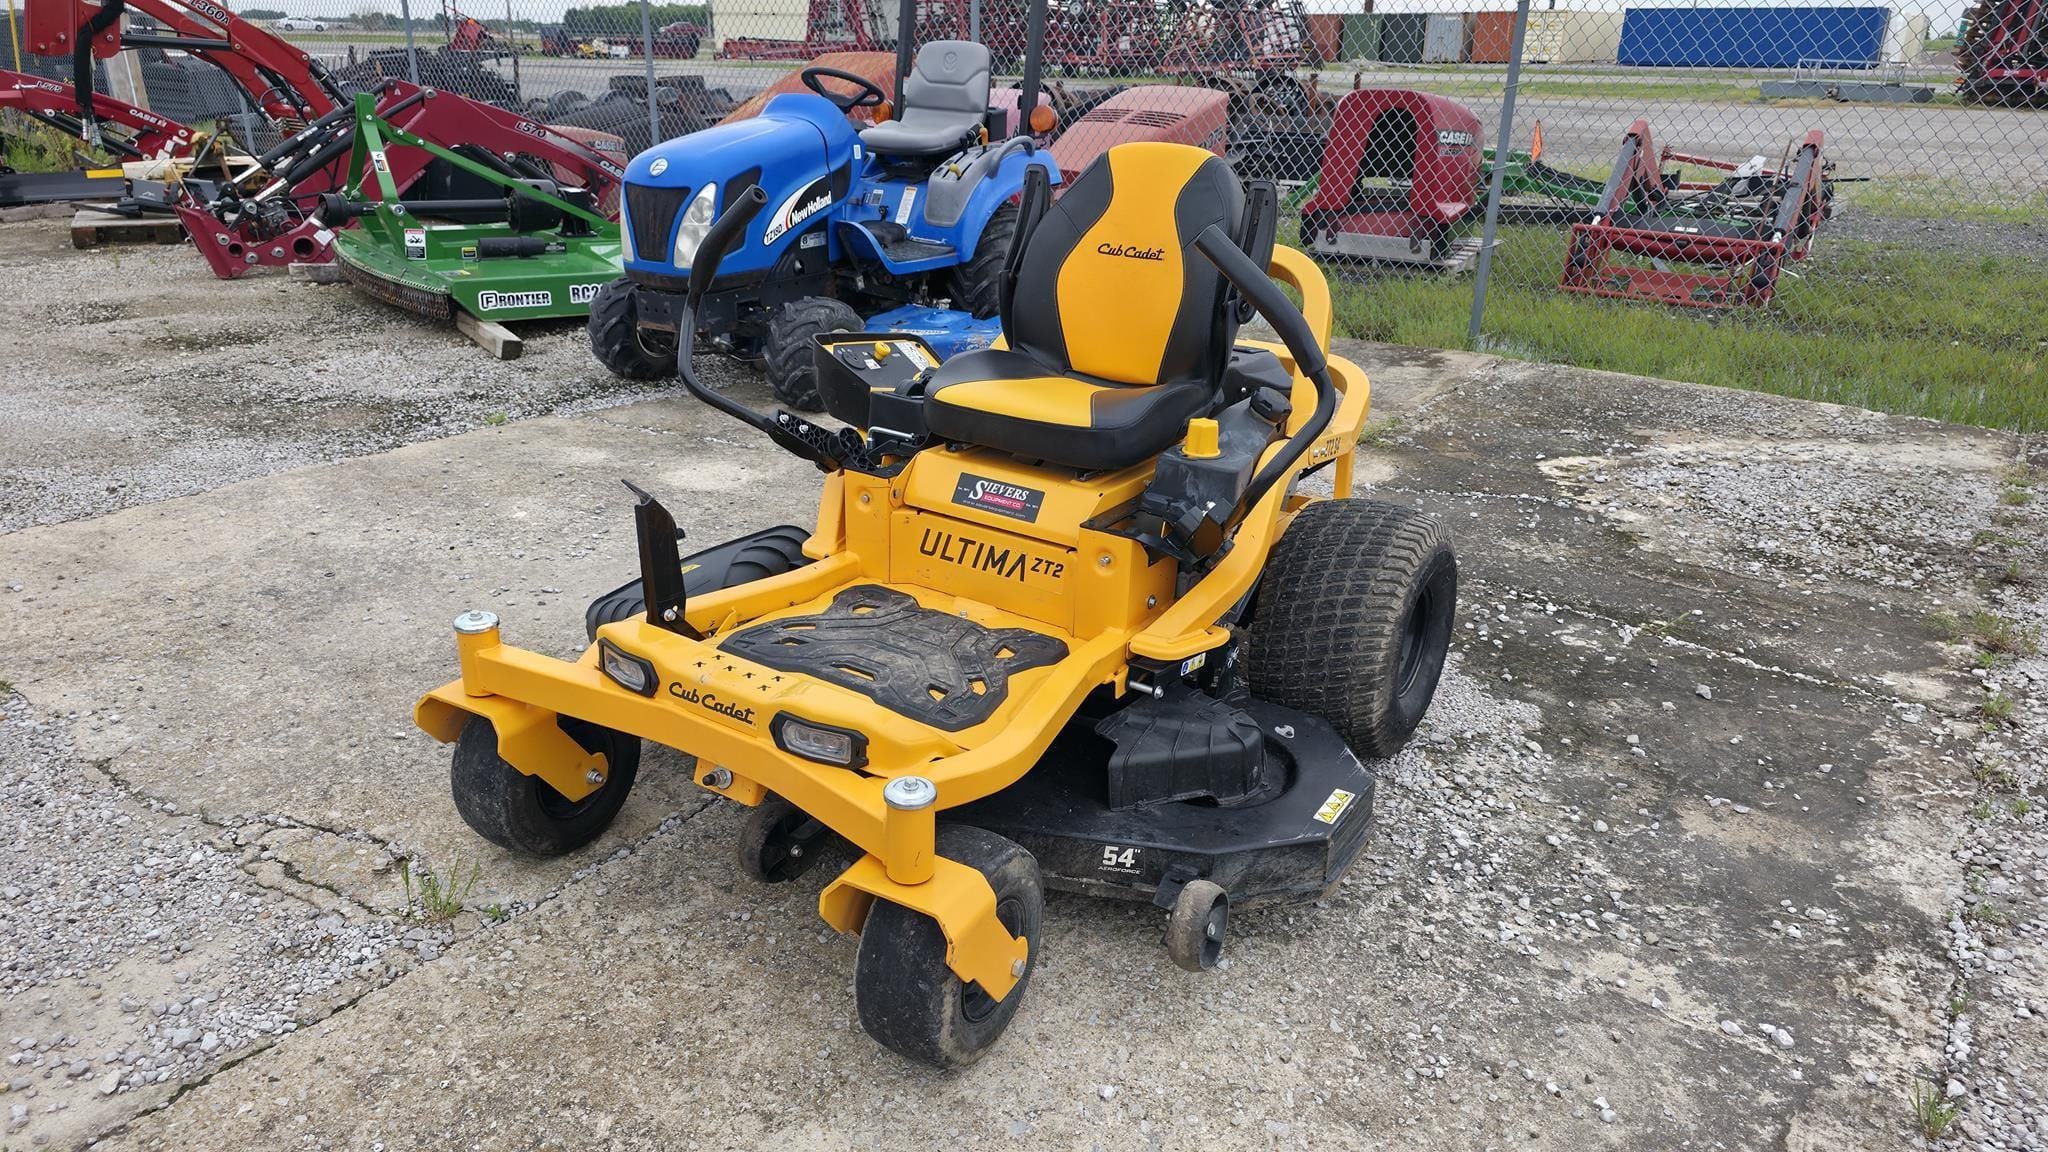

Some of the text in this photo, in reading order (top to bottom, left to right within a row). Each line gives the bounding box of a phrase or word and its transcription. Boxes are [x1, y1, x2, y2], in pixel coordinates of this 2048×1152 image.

[129, 108, 157, 124] CASE
[516, 121, 546, 138] L570
[1439, 130, 1466, 145] CASE
[600, 160, 625, 178] CAS
[792, 190, 832, 226] New Holland
[1097, 242, 1166, 261] Cub Cadet
[480, 291, 551, 310] FRONTIER
[570, 285, 602, 302] RC2
[967, 480, 1030, 501] SIEVERS
[919, 527, 1065, 583] ULTIMA ZT2
[668, 681, 756, 726] Cub Cadet
[1102, 845, 1141, 868] 54"
[1097, 866, 1142, 875] AEROFORCE
